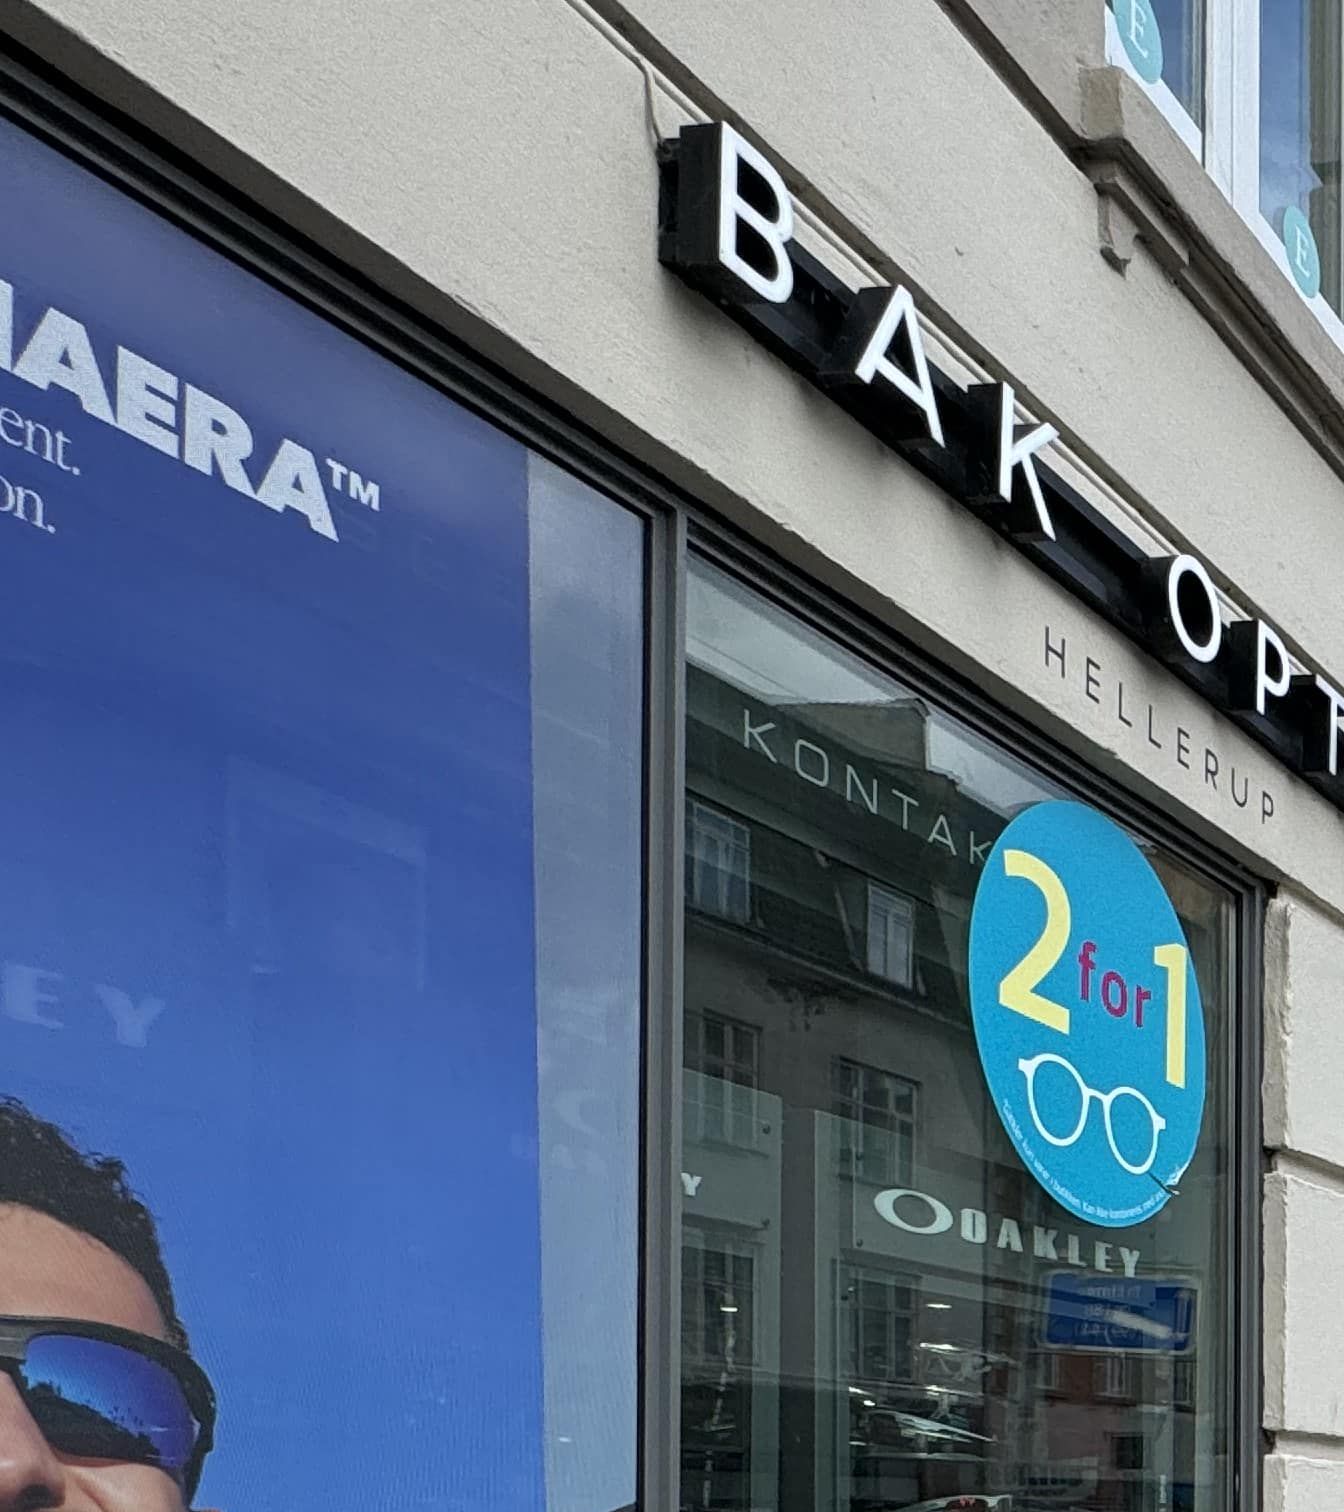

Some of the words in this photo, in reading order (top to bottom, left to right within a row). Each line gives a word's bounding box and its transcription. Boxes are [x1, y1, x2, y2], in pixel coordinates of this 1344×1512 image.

[719, 121, 1059, 541] BAK
[1044, 625, 1275, 825] HELLERUP
[999, 849, 1072, 1035] 2
[1078, 940, 1152, 1029] for
[1153, 942, 1188, 1089] 1
[960, 1207, 1141, 1278] OAKLEY
